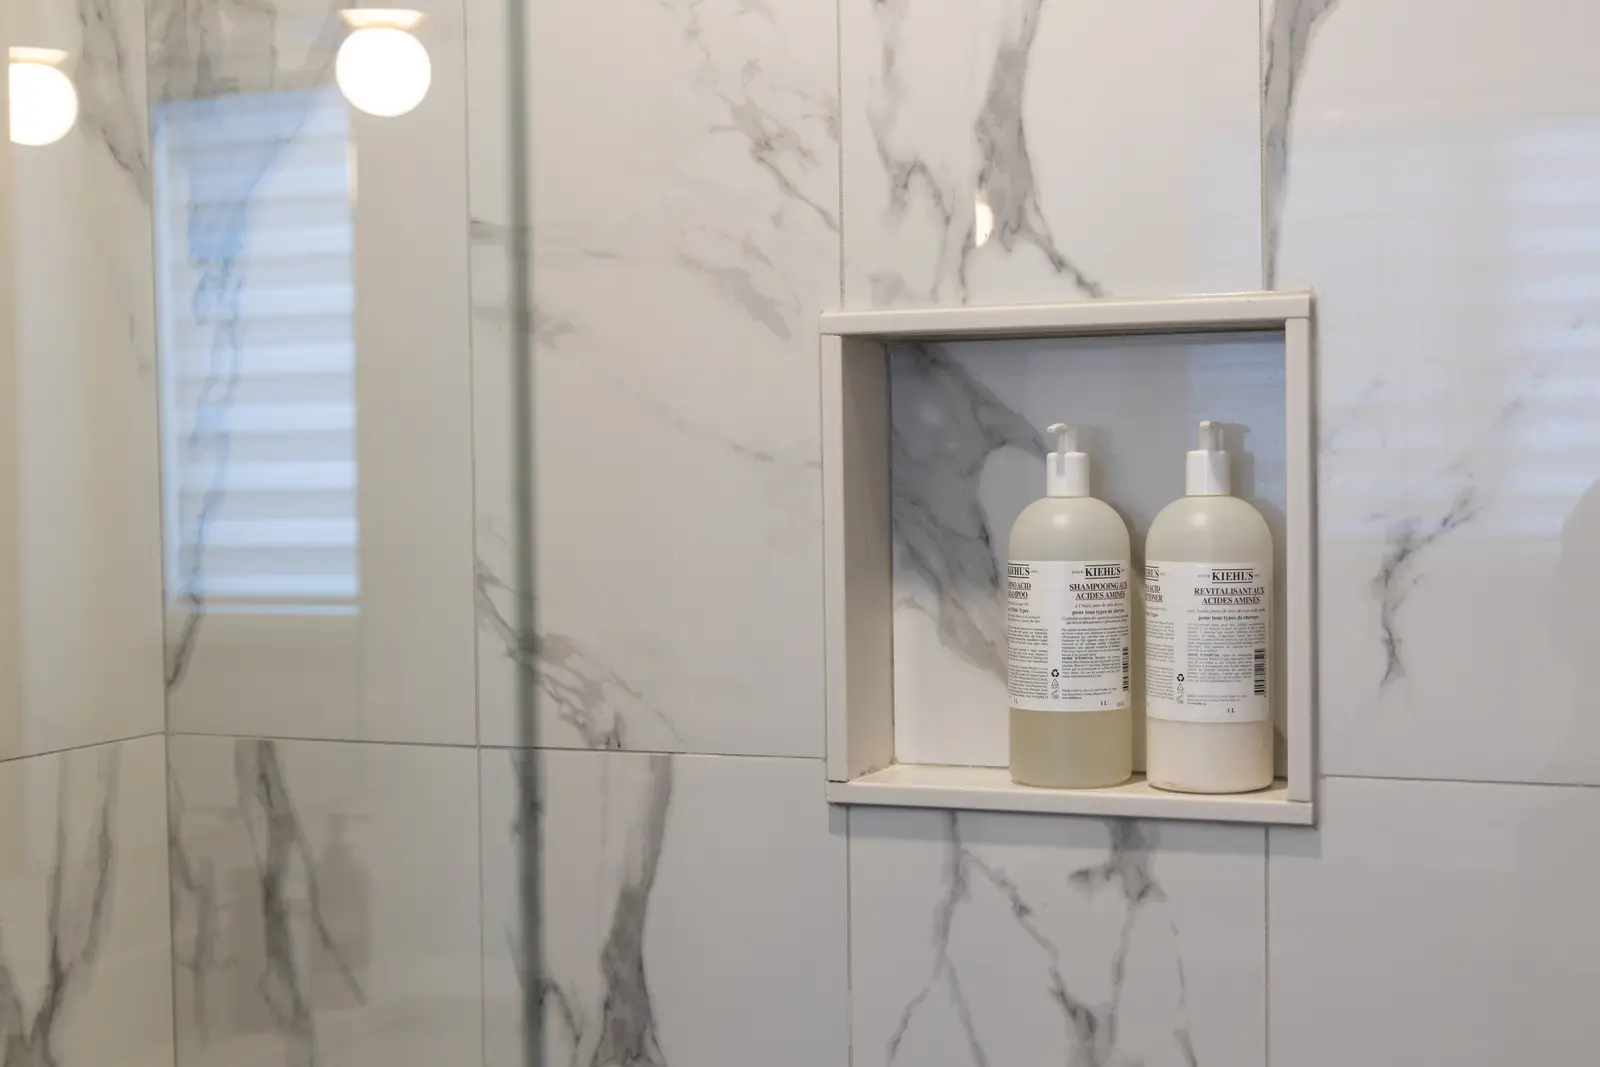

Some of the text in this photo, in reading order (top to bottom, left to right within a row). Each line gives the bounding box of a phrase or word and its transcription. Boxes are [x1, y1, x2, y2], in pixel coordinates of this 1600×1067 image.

[1085, 566, 1121, 577] KIEHL'S
[1212, 571, 1254, 581] KIEHL'S
[1069, 582, 1119, 591] SHAMPOOING
[1194, 586, 1265, 595] REVITALISANT AUX
[1075, 592, 1104, 600] ACIDES
[1202, 596, 1232, 604] ACIDES
